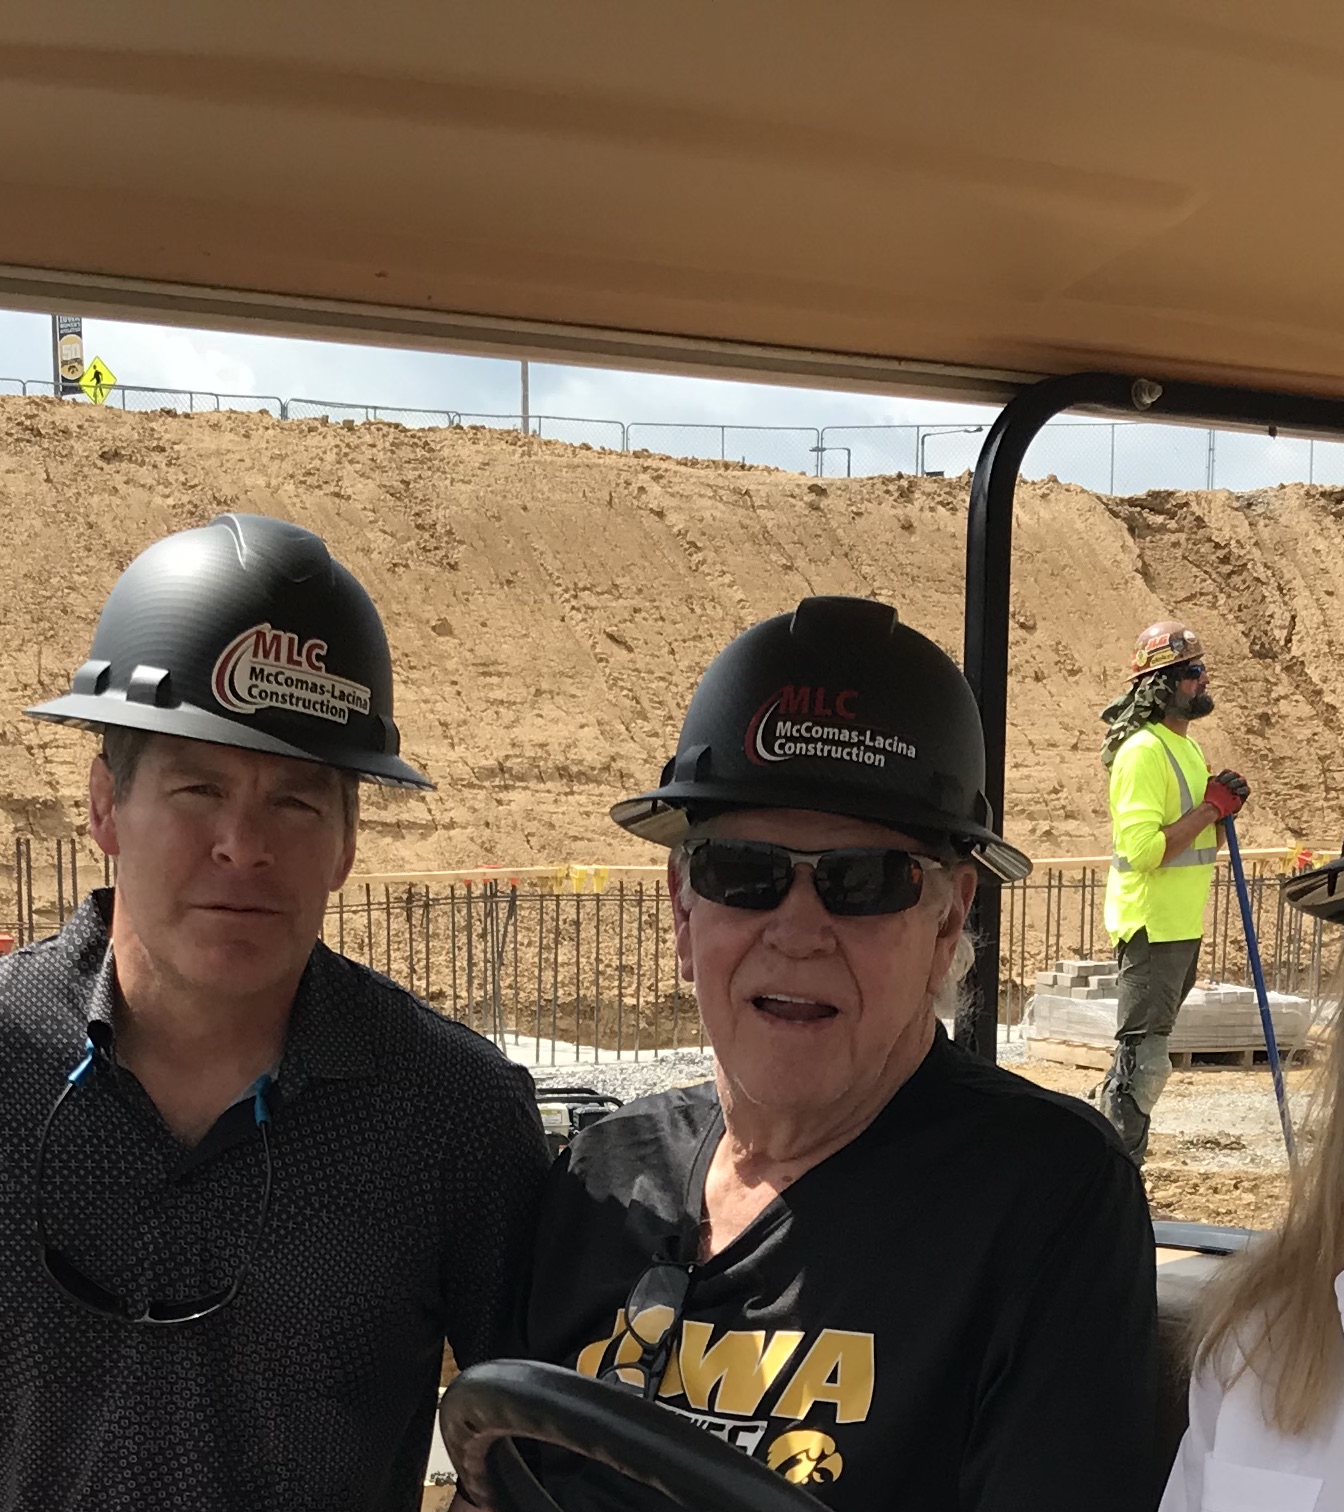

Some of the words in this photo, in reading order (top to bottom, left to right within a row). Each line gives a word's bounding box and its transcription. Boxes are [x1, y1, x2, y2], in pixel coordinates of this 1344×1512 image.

[252, 630, 327, 672] MLC
[247, 684, 346, 720] Construction
[249, 666, 369, 712] McComas-Lacina
[778, 685, 859, 720] MLC
[773, 739, 885, 768] Construction
[775, 720, 917, 759] McComas-Lacina
